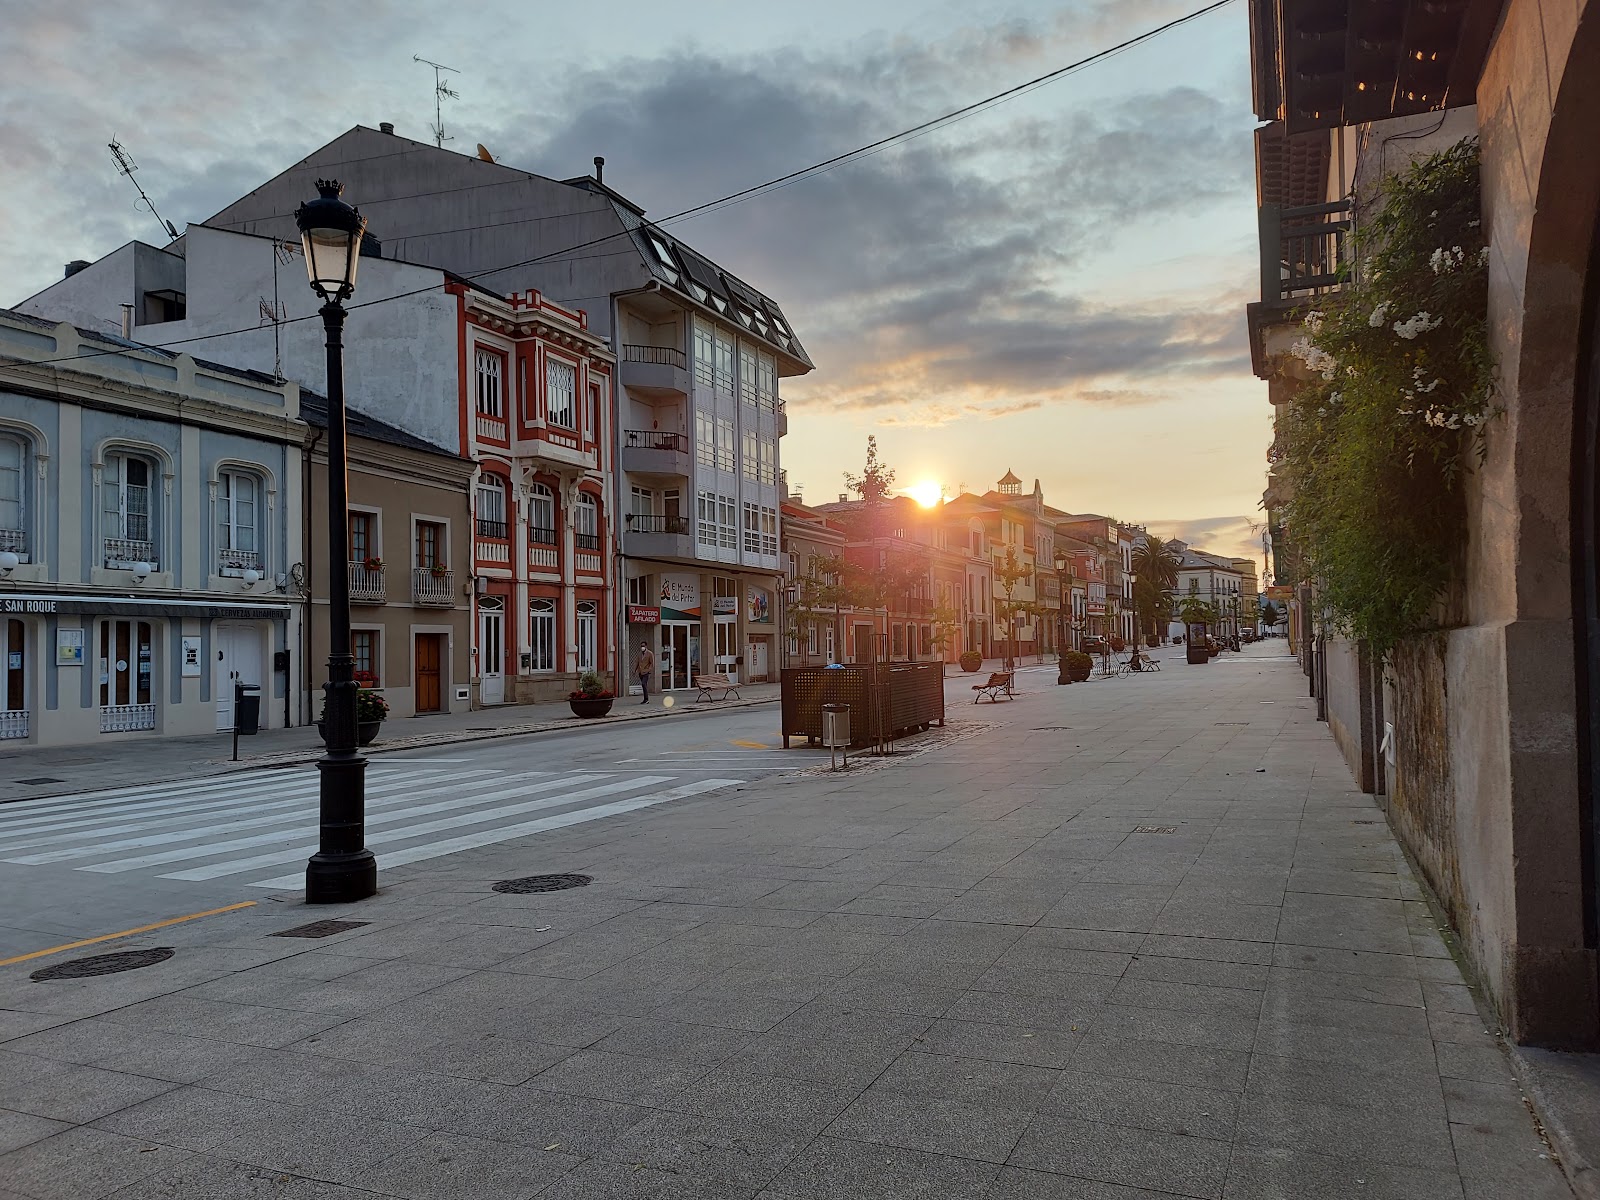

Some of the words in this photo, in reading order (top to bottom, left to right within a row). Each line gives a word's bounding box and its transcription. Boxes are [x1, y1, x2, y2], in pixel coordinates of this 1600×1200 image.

[5, 600, 24, 612] SAN
[27, 601, 56, 612] ROQUE
[221, 608, 250, 618] CERVEZAS
[252, 609, 284, 619] ALHAMBRA
[631, 608, 659, 616] ZAPATERO
